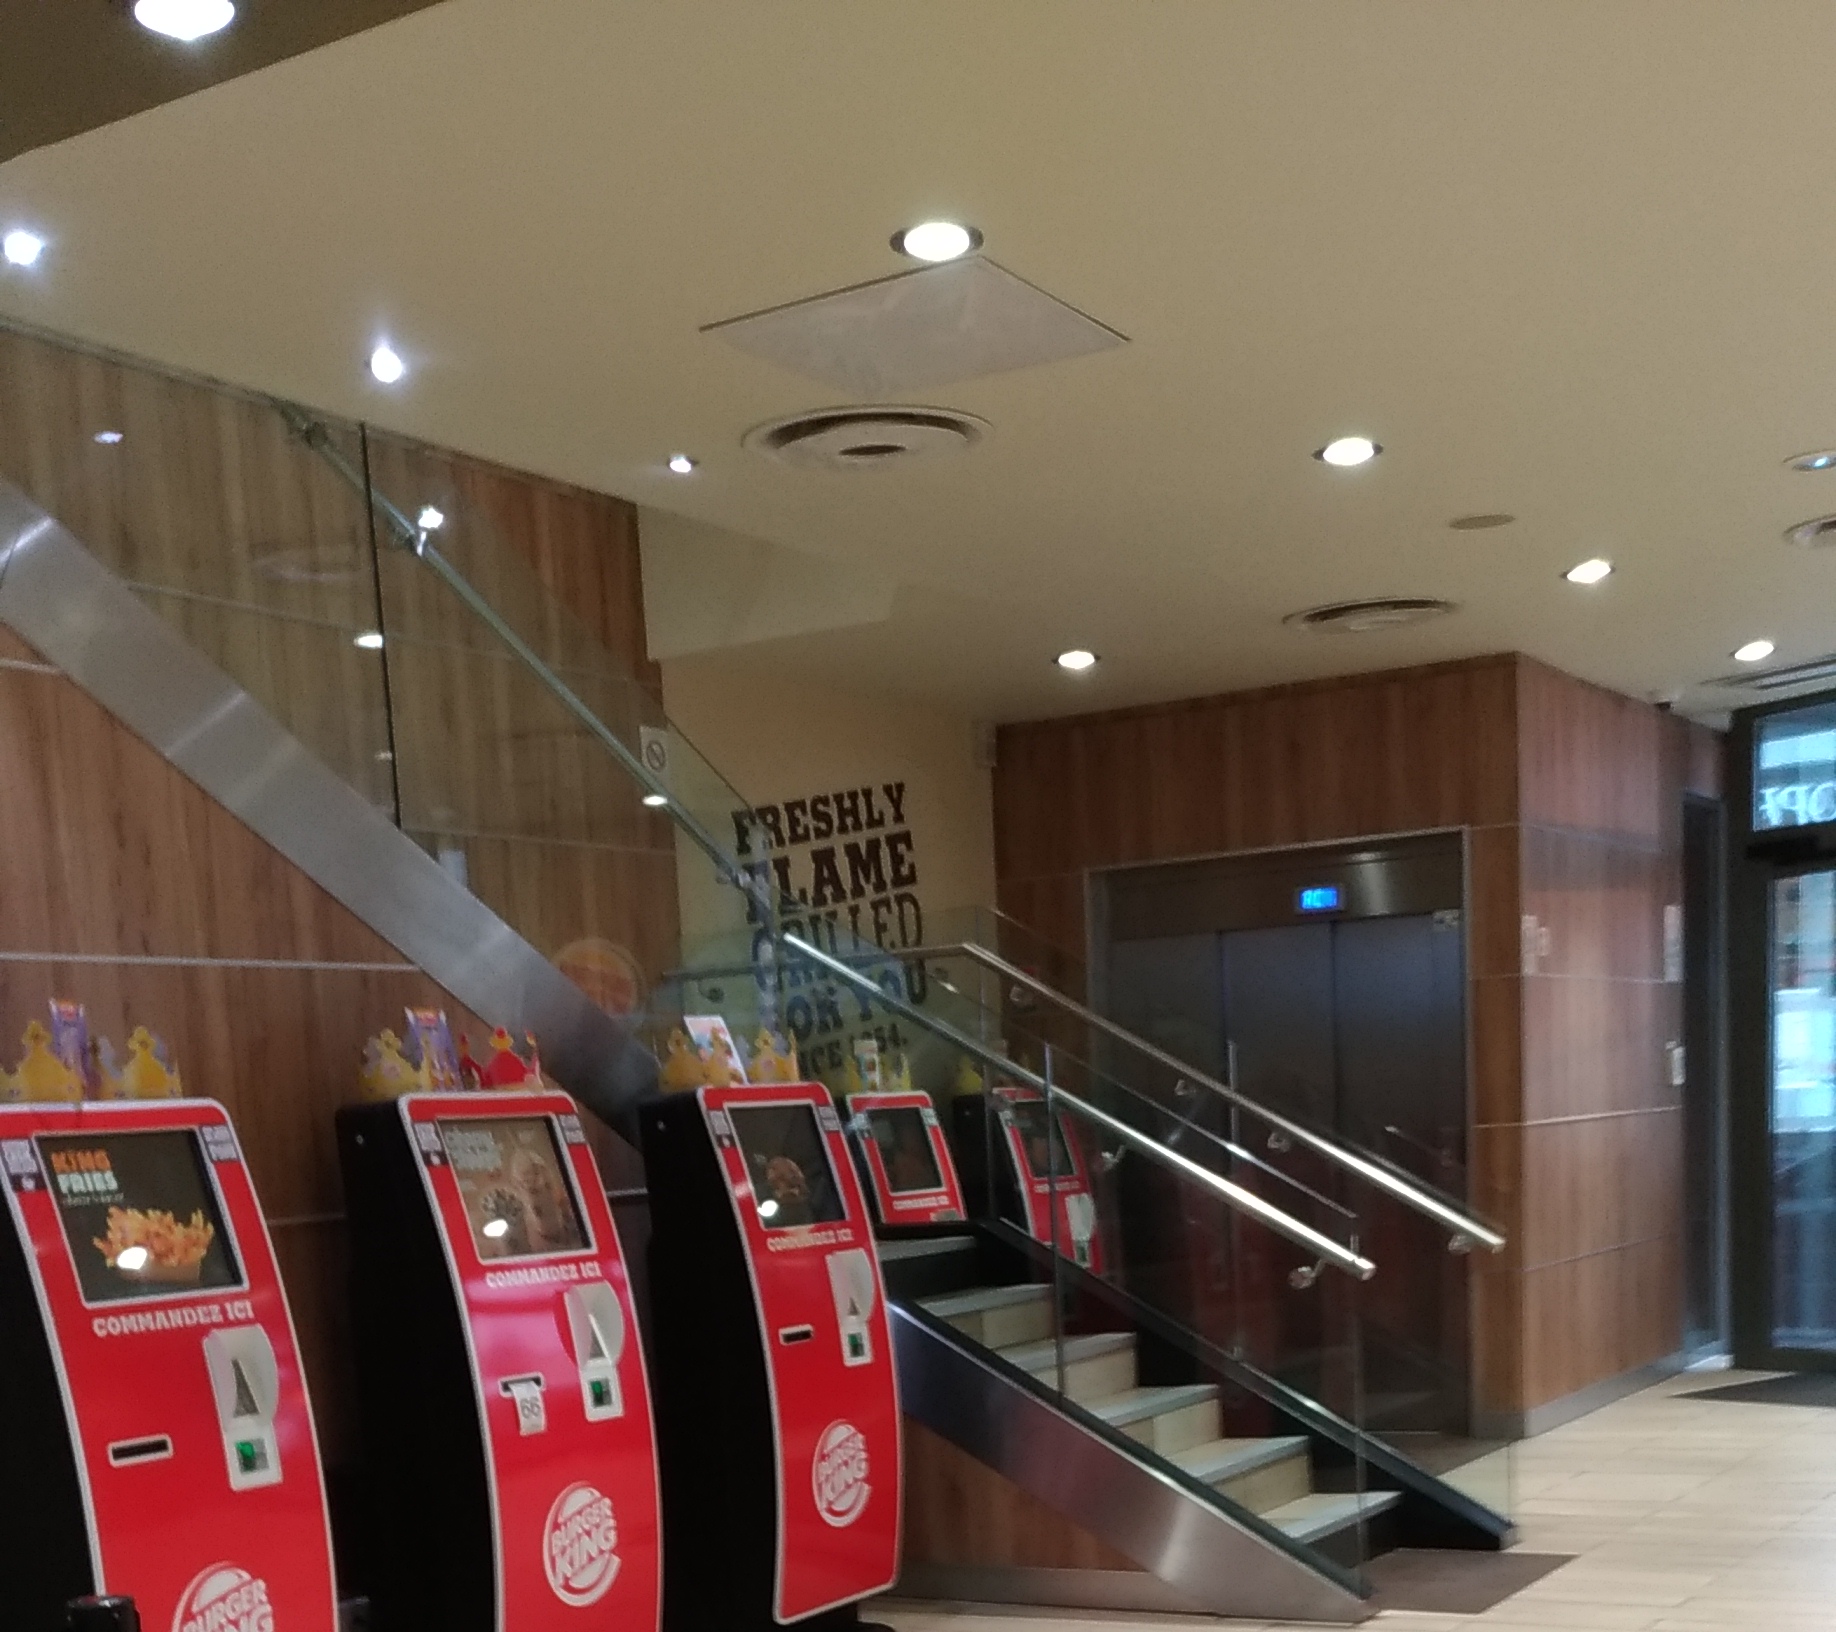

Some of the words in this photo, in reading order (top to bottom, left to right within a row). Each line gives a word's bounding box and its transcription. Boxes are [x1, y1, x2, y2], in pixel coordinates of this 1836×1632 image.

[730, 781, 906, 856] FRESHLY
[92, 1305, 224, 1338] COMMANDEZ
[224, 1300, 254, 1321] ICI
